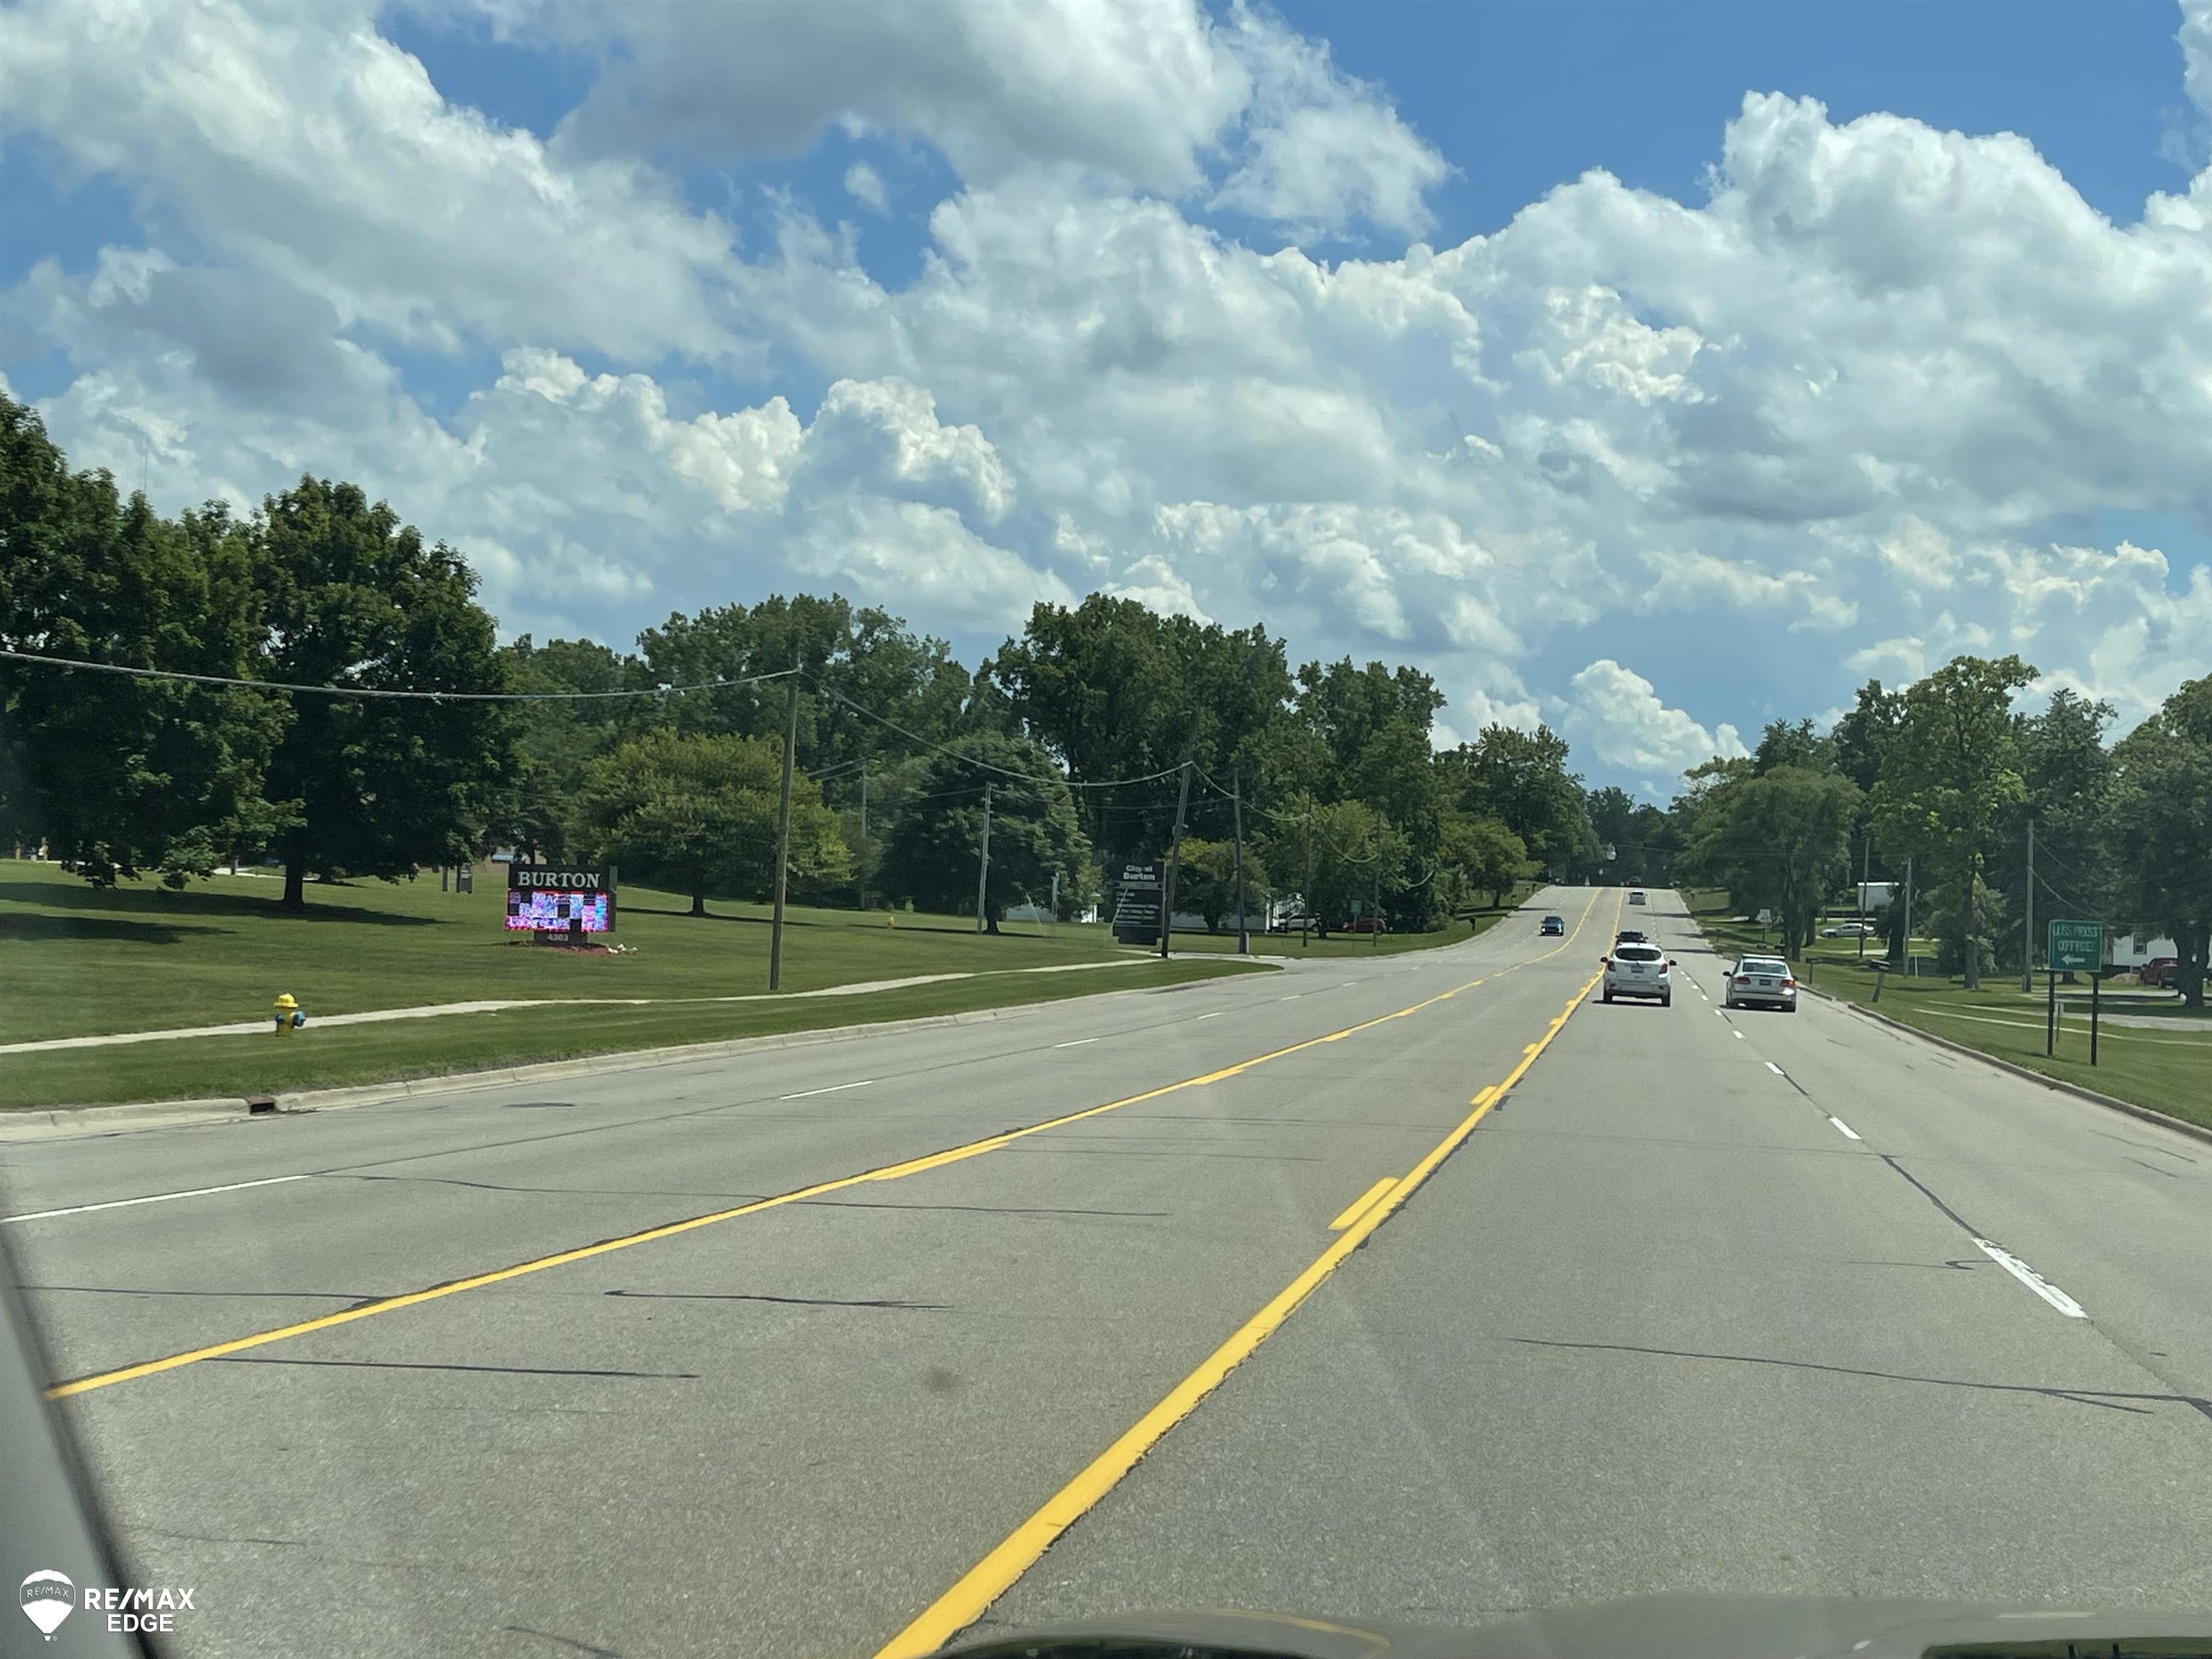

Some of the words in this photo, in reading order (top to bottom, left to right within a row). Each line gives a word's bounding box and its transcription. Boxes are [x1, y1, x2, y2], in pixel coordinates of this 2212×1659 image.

[1125, 865, 1141, 873] City
[518, 871, 600, 888] BURTON
[1123, 872, 1156, 881] Burton
